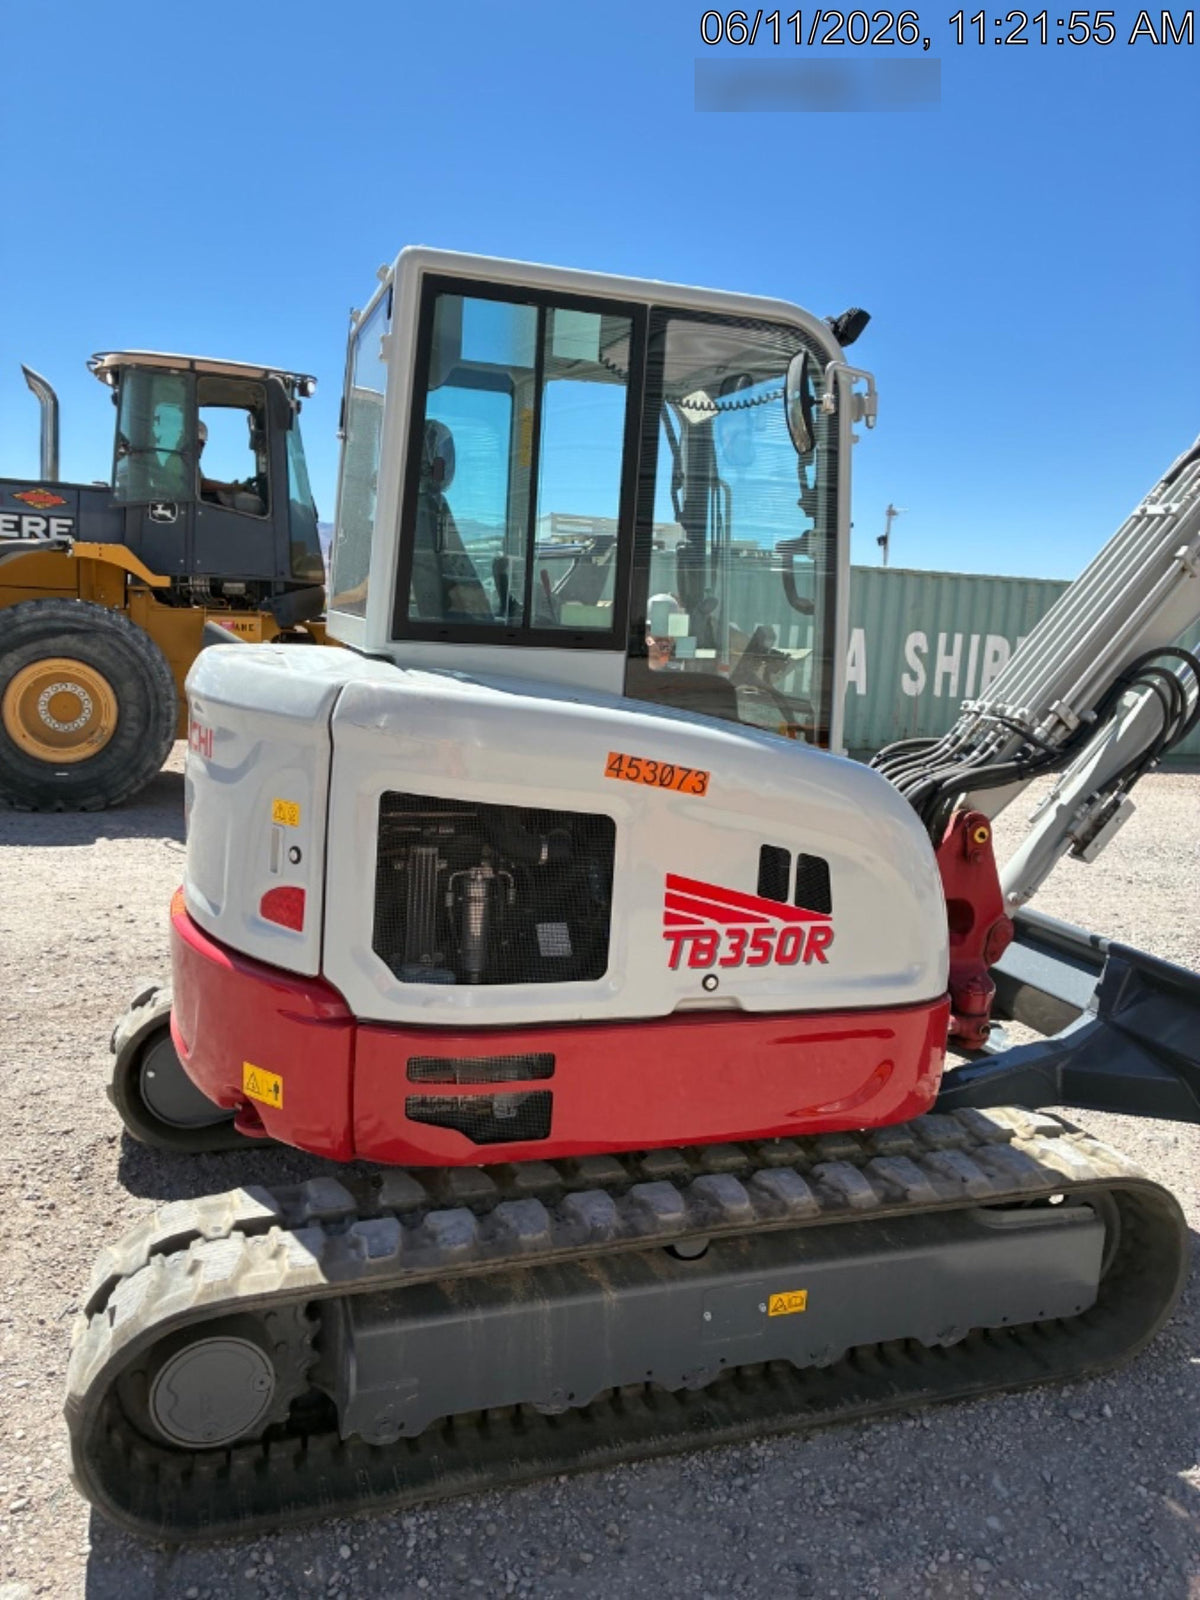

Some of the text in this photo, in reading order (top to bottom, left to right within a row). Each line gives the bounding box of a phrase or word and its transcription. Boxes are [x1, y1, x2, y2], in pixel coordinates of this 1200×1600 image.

[0, 513, 74, 541] ERE
[902, 631, 1029, 697] SHIP
[607, 753, 708, 794] 453073
[663, 926, 834, 970] TB350R
